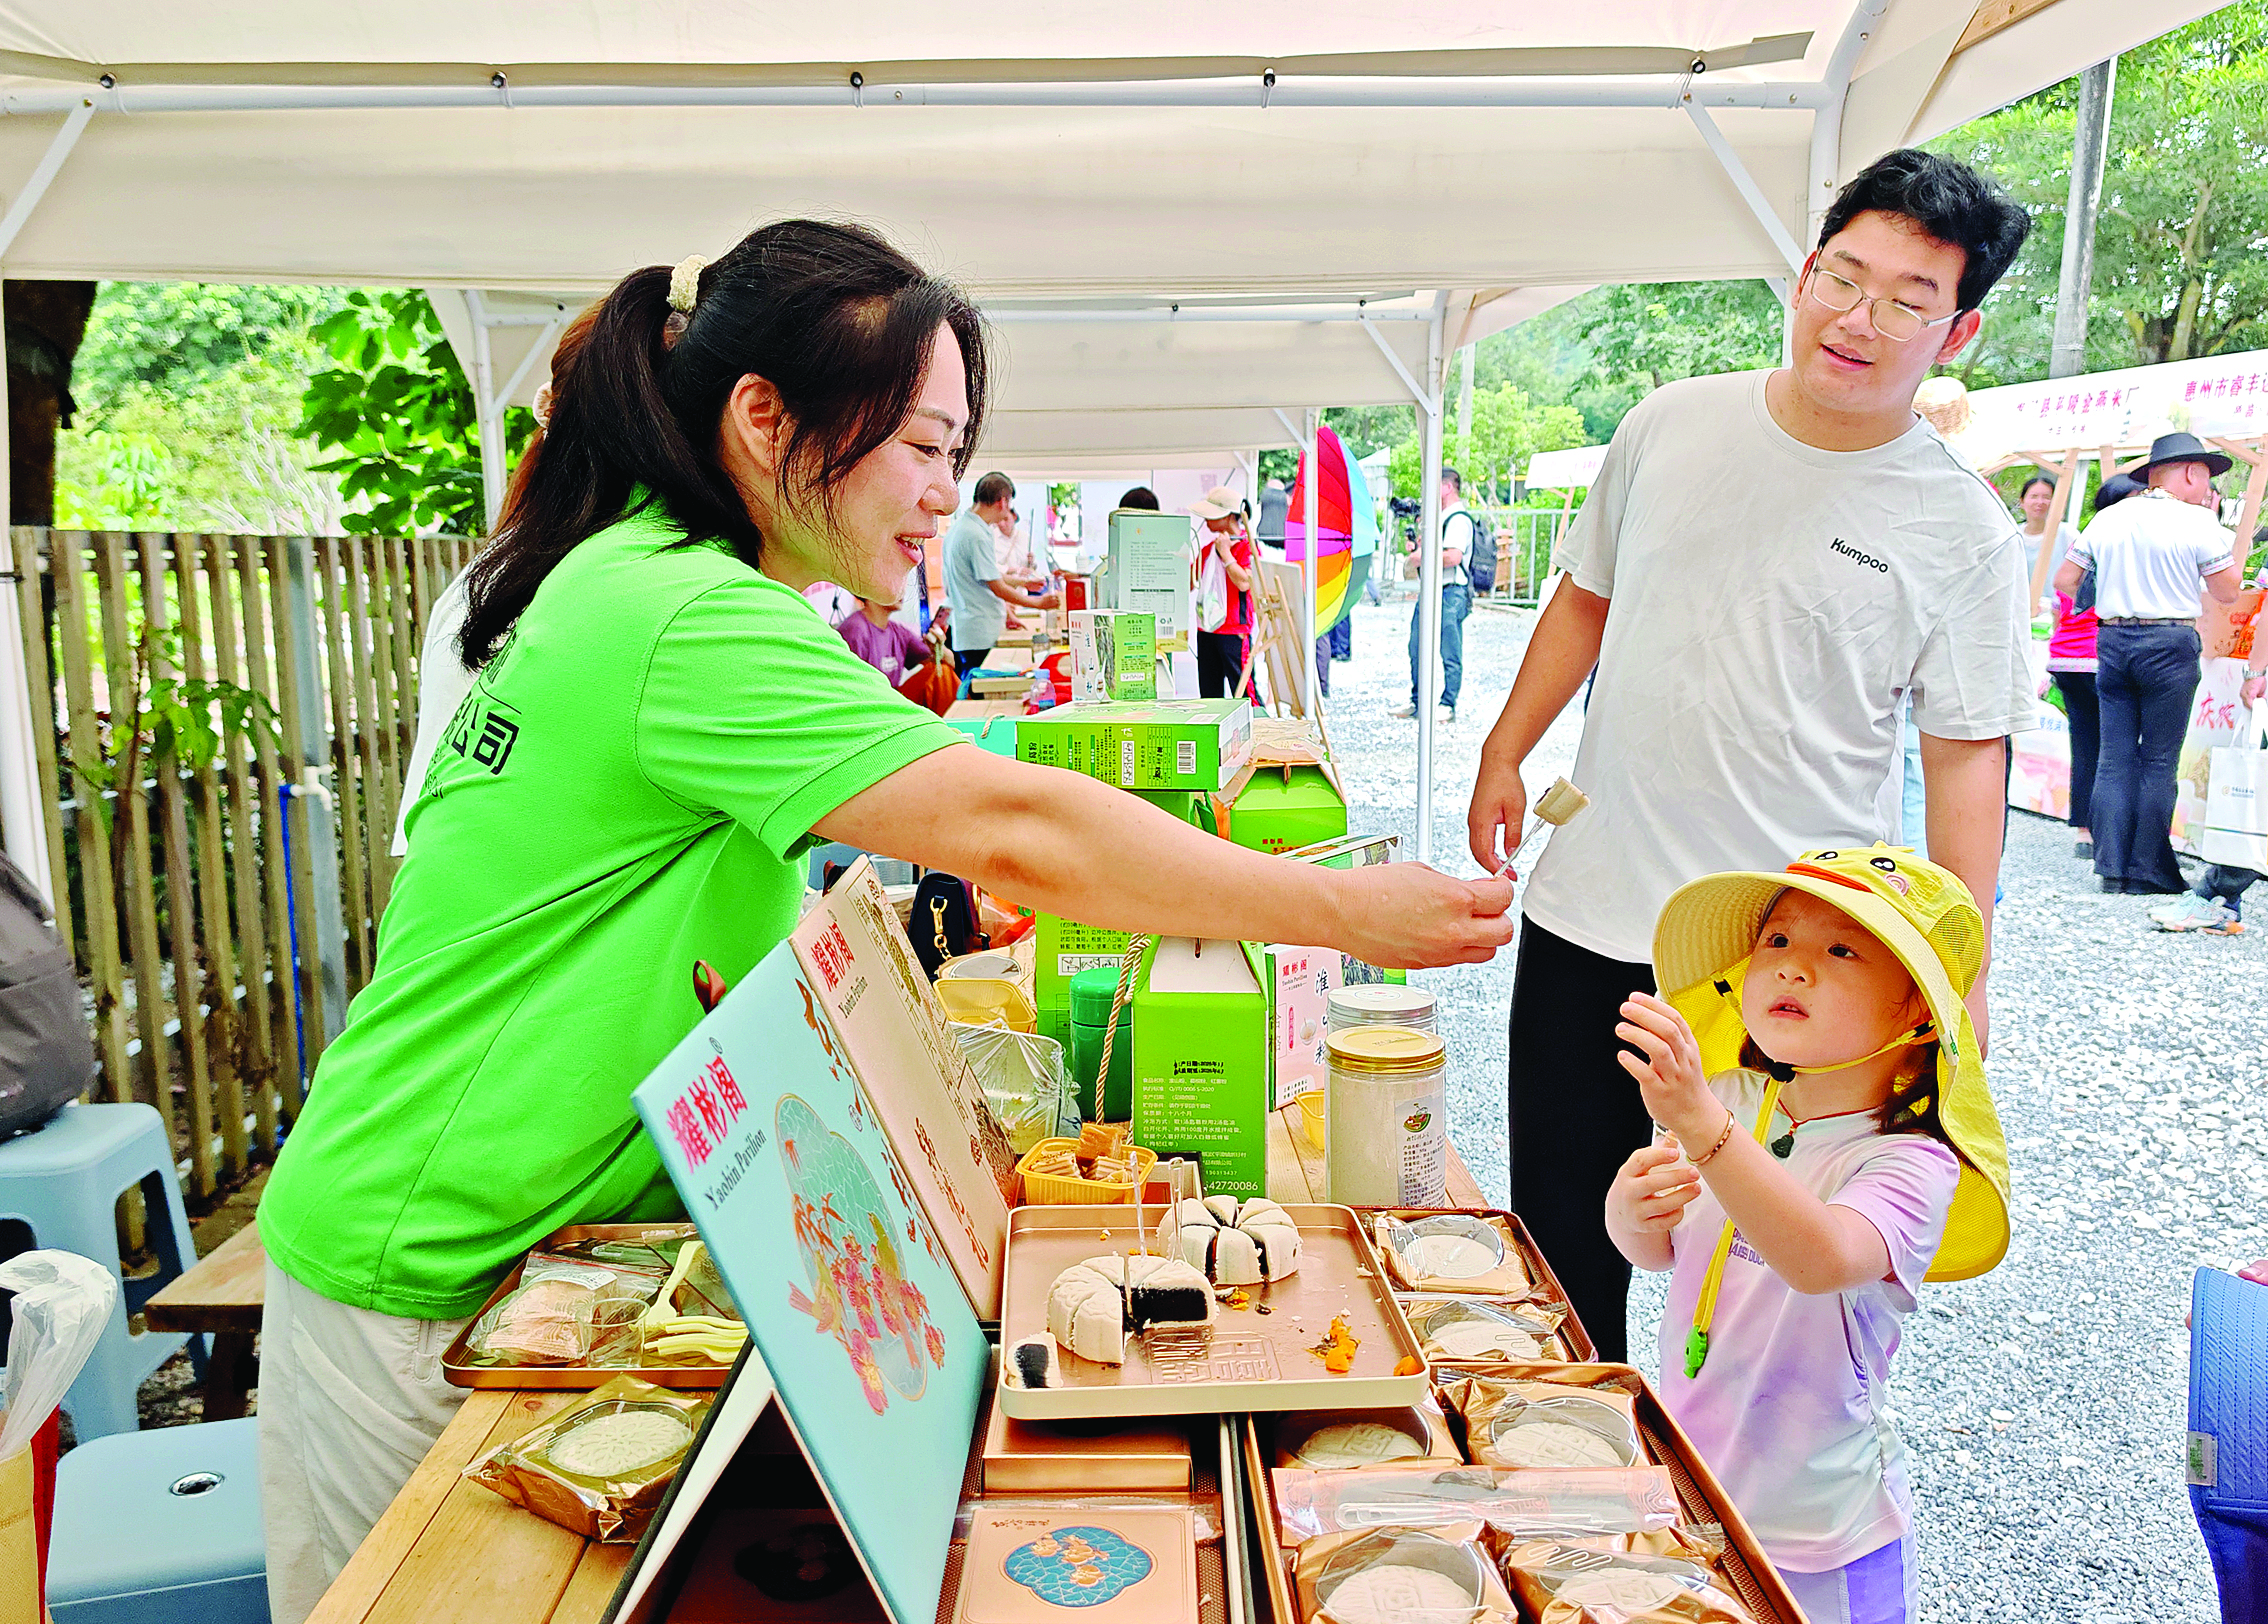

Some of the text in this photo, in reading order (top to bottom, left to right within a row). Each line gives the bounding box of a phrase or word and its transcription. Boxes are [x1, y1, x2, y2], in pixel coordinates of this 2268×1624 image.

[1829, 537, 1889, 573] Kumpoo
[443, 690, 520, 776] 公司
[811, 922, 856, 992] 耀彬阁
[1282, 958, 1308, 977] 耀彬阁
[838, 992, 856, 1019] Yaobin
[666, 1055, 749, 1174] 耀彬阁
[704, 1128, 768, 1212] Yaobin Pavilion
